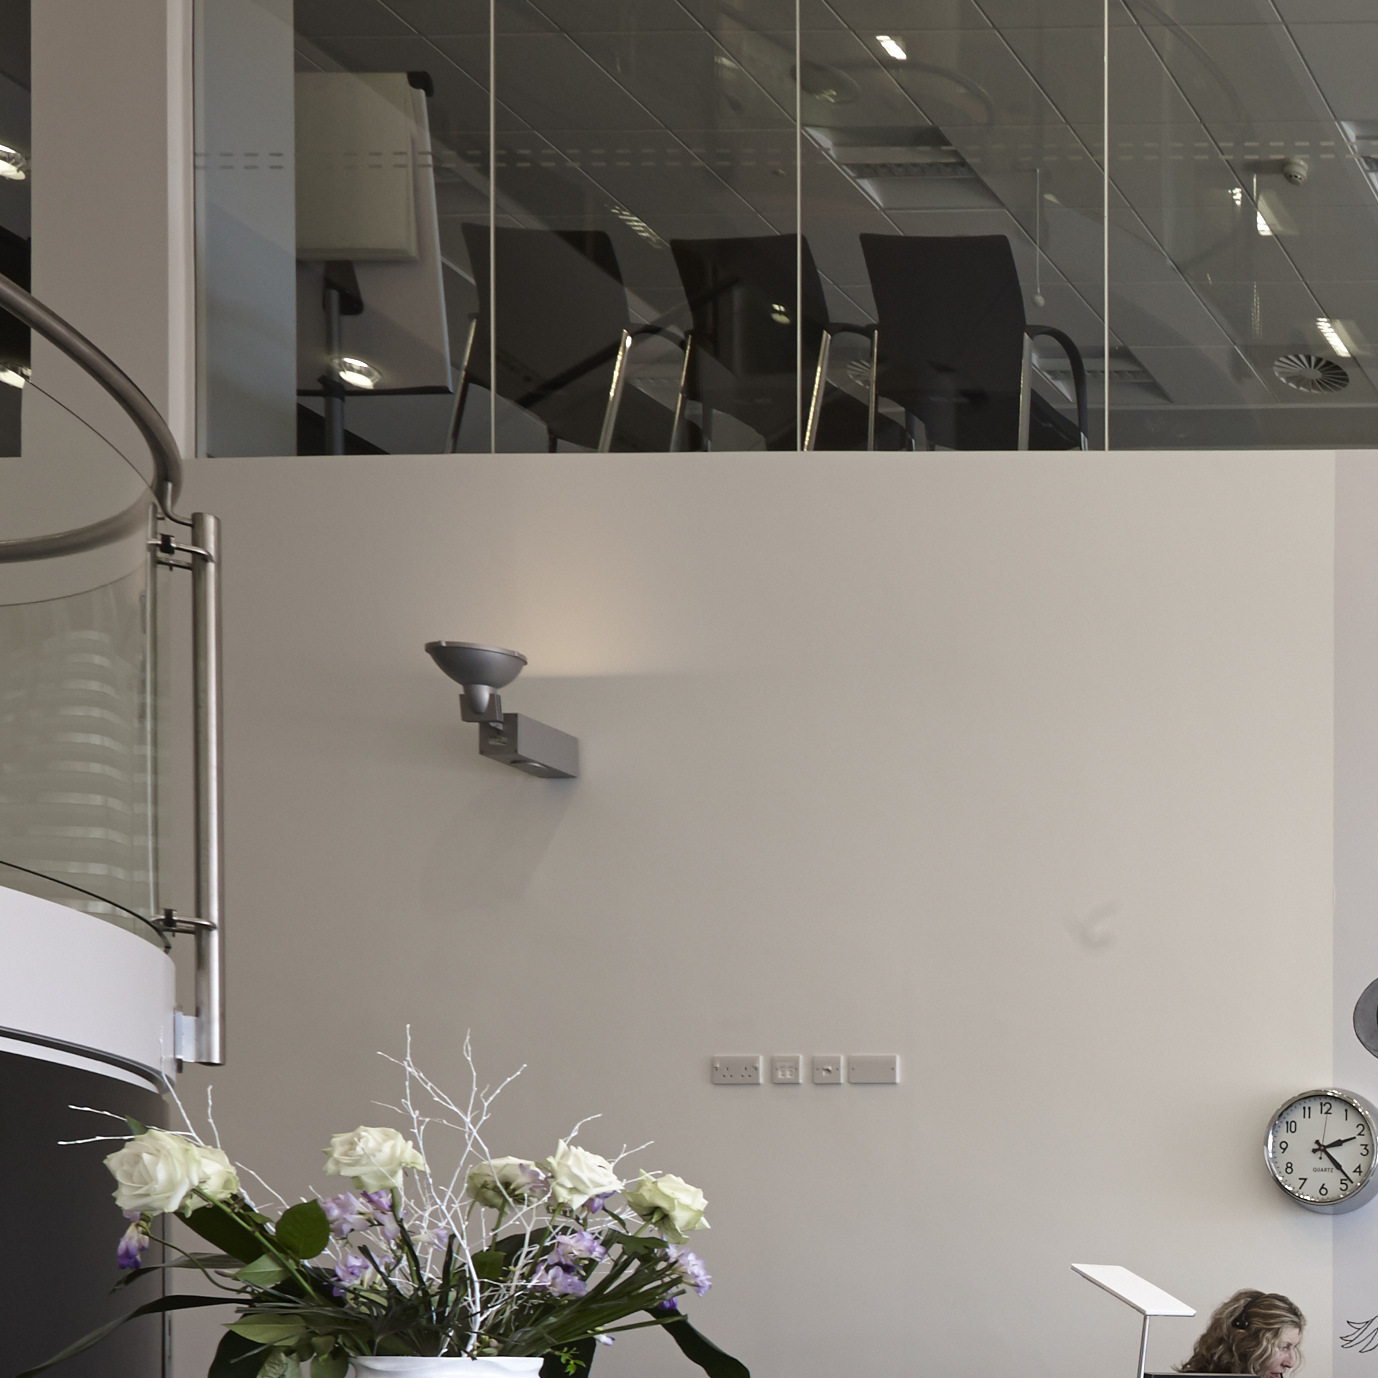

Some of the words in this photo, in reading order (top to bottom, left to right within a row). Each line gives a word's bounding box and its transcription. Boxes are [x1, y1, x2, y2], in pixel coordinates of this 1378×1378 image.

[1303, 1106, 1311, 1119] 11
[1320, 1102, 1332, 1115] 12
[1345, 1109, 1348, 1121] 1
[1286, 1121, 1297, 1133] 10
[1356, 1124, 1365, 1137] 2
[1280, 1141, 1289, 1154] 9
[1360, 1144, 1369, 1156] 3
[1285, 1162, 1293, 1175] 8
[1353, 1164, 1363, 1176] 4
[1299, 1178, 1307, 1190] 7
[1319, 1183, 1328, 1196] 6
[1340, 1179, 1349, 1192] 5
